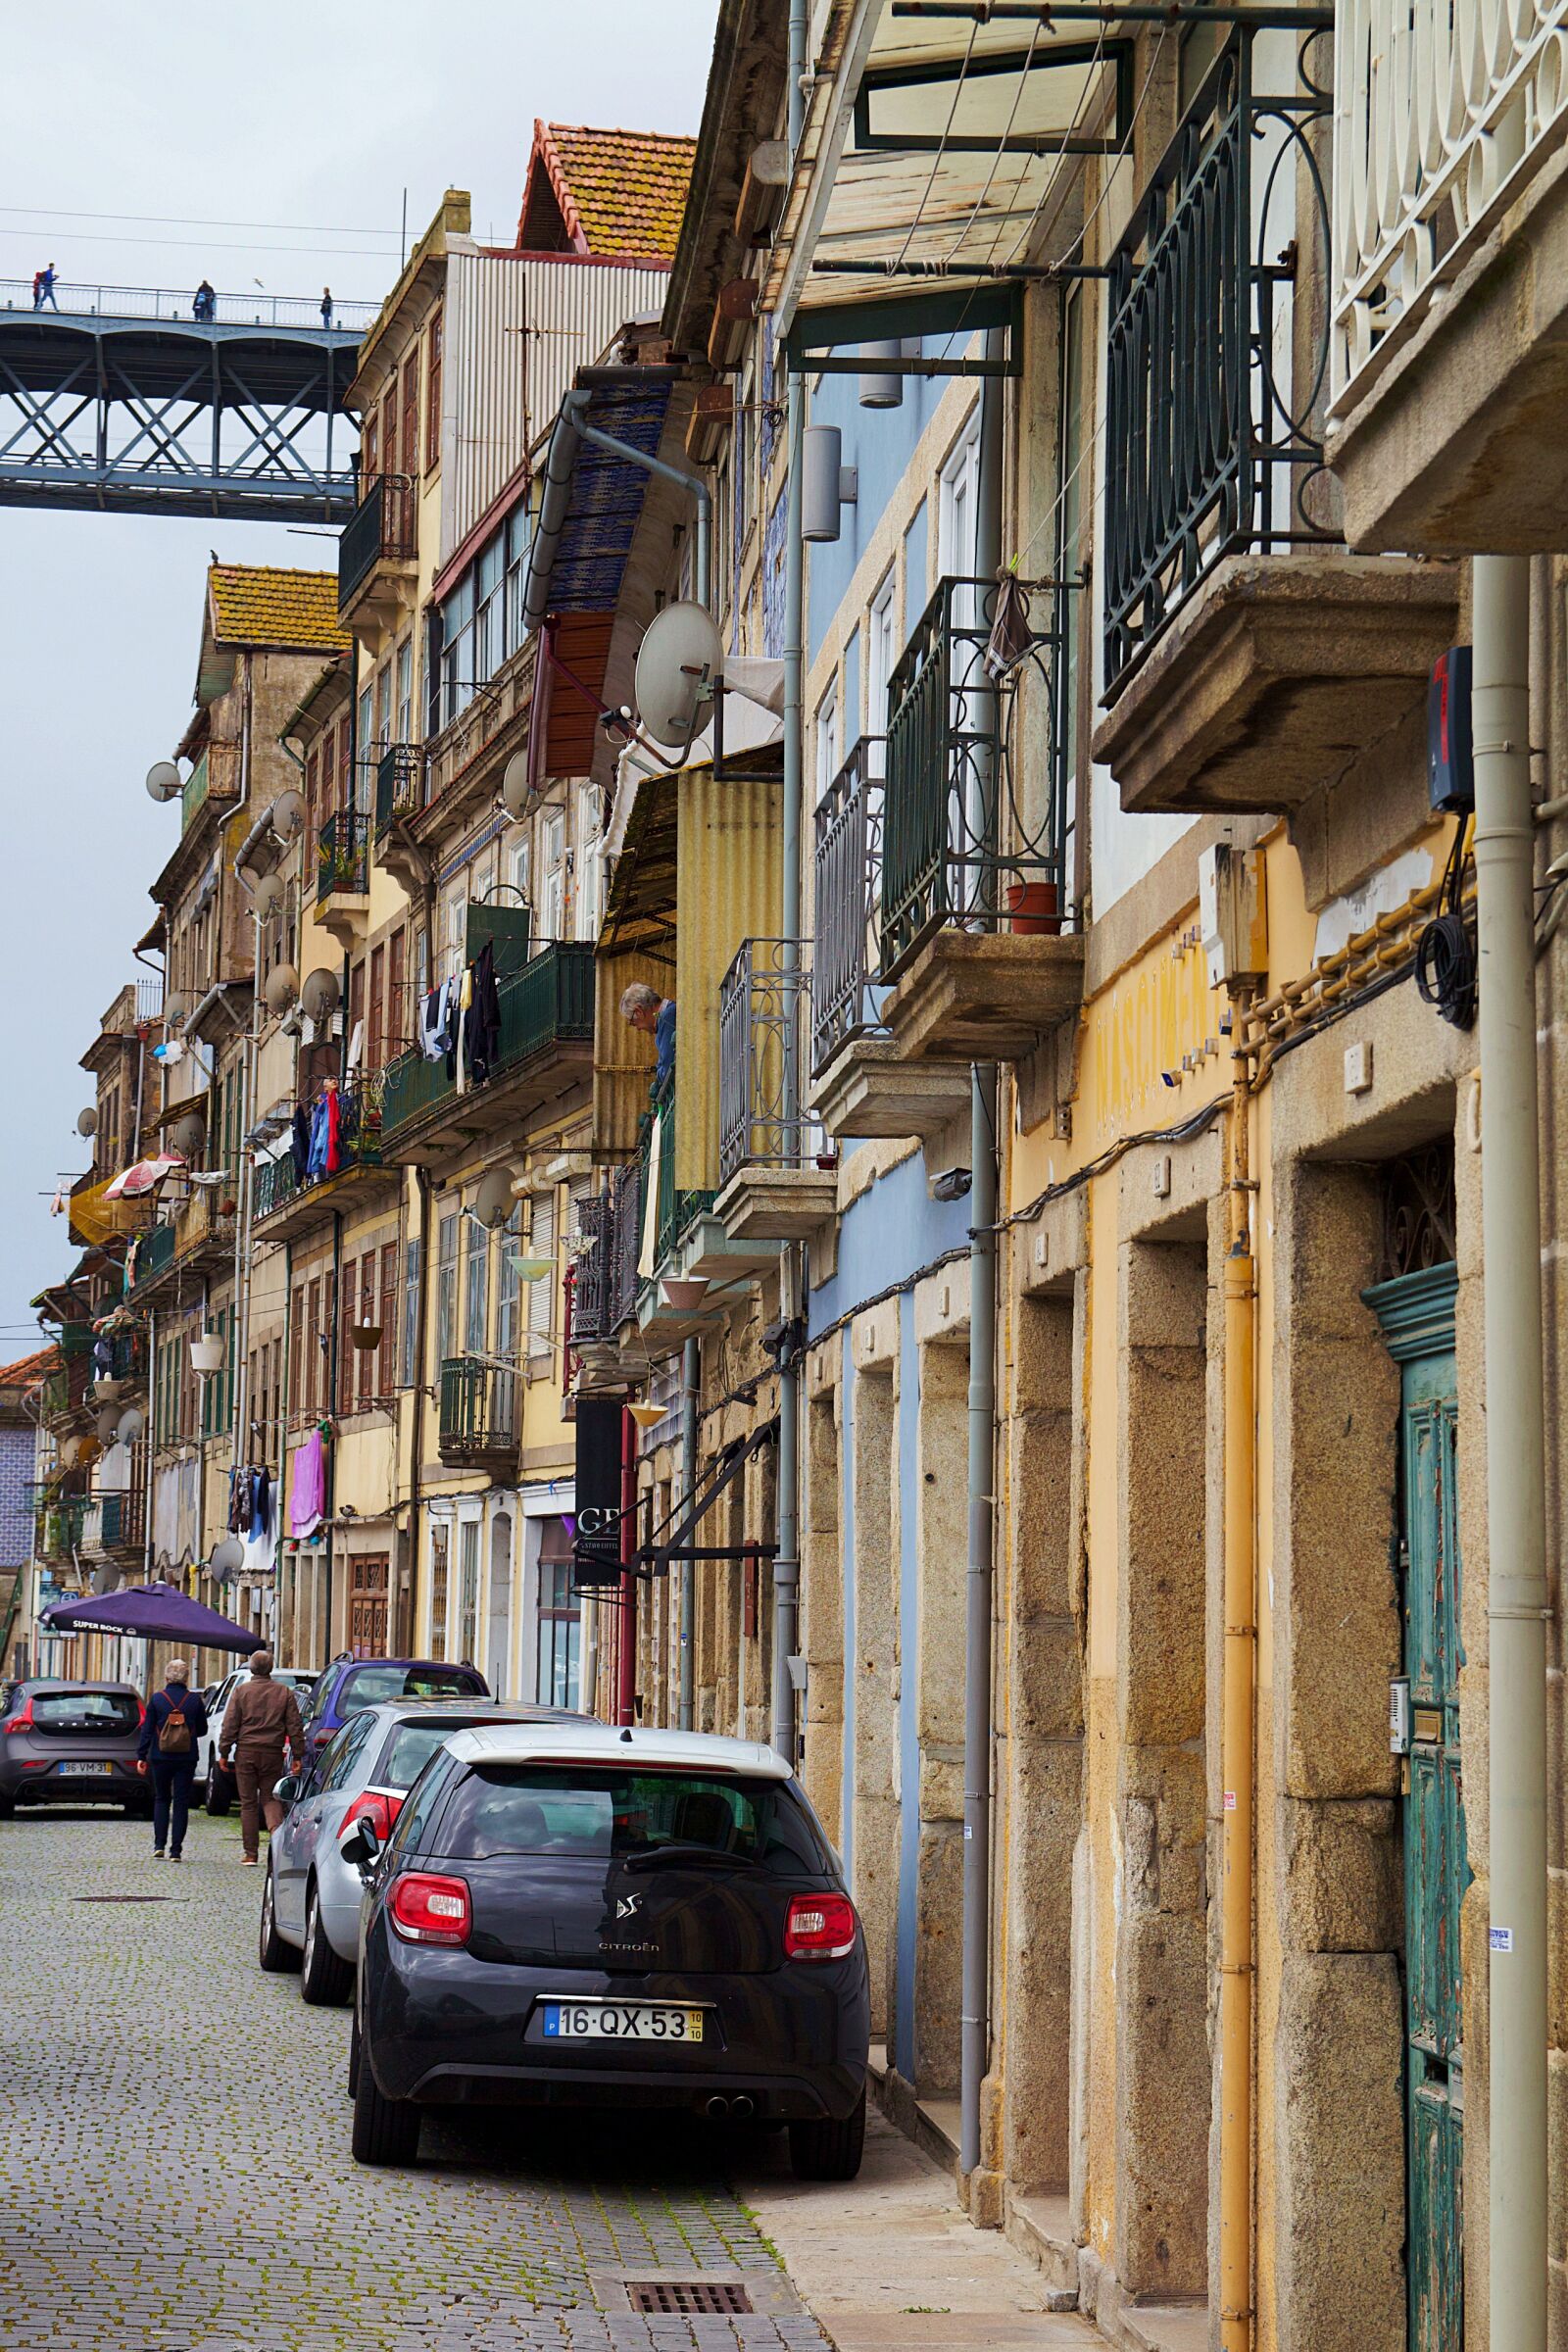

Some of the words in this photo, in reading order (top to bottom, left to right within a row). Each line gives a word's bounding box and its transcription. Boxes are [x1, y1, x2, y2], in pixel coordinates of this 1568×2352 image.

[73, 1620, 99, 1630] SUPER
[100, 1624, 123, 1634] BOCK
[691, 2013, 702, 2023] 10
[691, 2030, 702, 2039] 10
